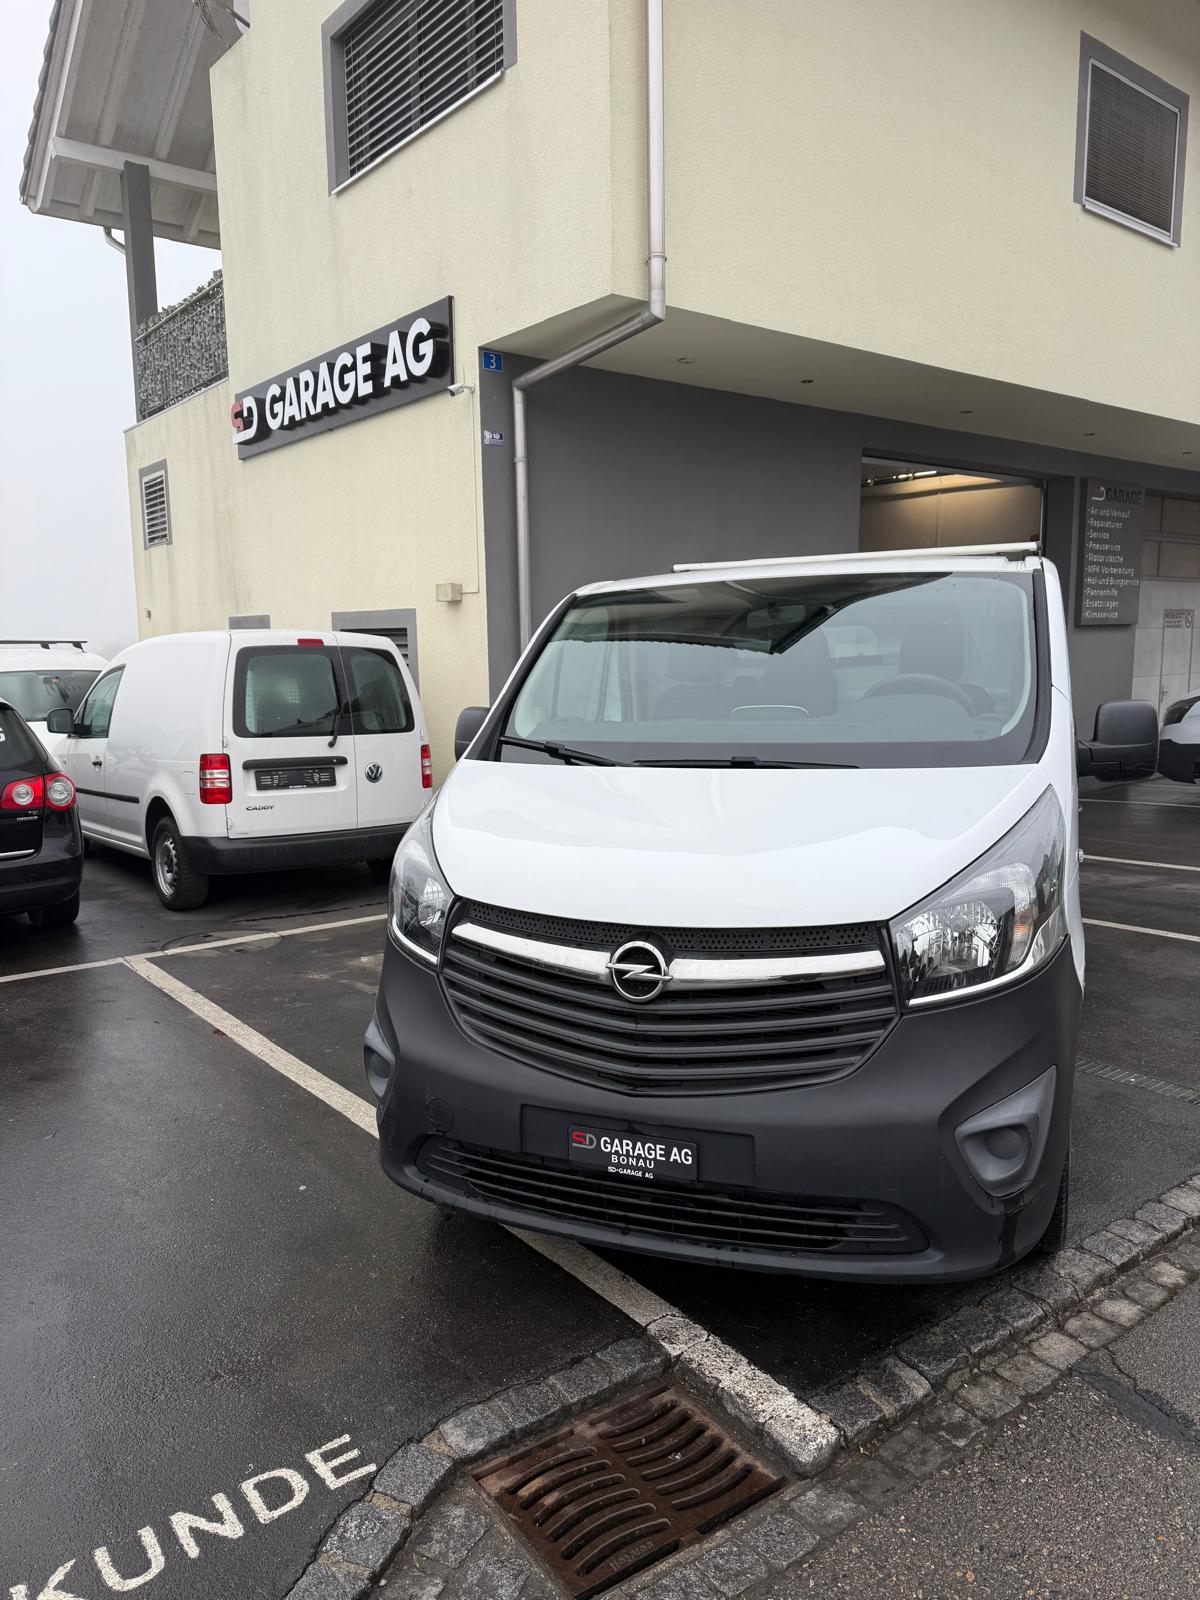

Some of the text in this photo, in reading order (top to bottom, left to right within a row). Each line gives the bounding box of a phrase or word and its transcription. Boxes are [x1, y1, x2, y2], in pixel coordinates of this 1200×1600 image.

[489, 353, 496, 369] 3
[231, 317, 434, 445] SD GARAGE AG
[1106, 487, 1142, 505] GARAGE
[1110, 508, 1130, 518] Verkauf
[1090, 517, 1123, 529] Reparaturen
[1089, 529, 1110, 539] Service
[1089, 541, 1121, 551] Pneuservice
[1085, 610, 1118, 619] Klimaservice
[571, 1131, 693, 1165] SD GARAGE AG
[611, 1155, 654, 1169] BONAU
